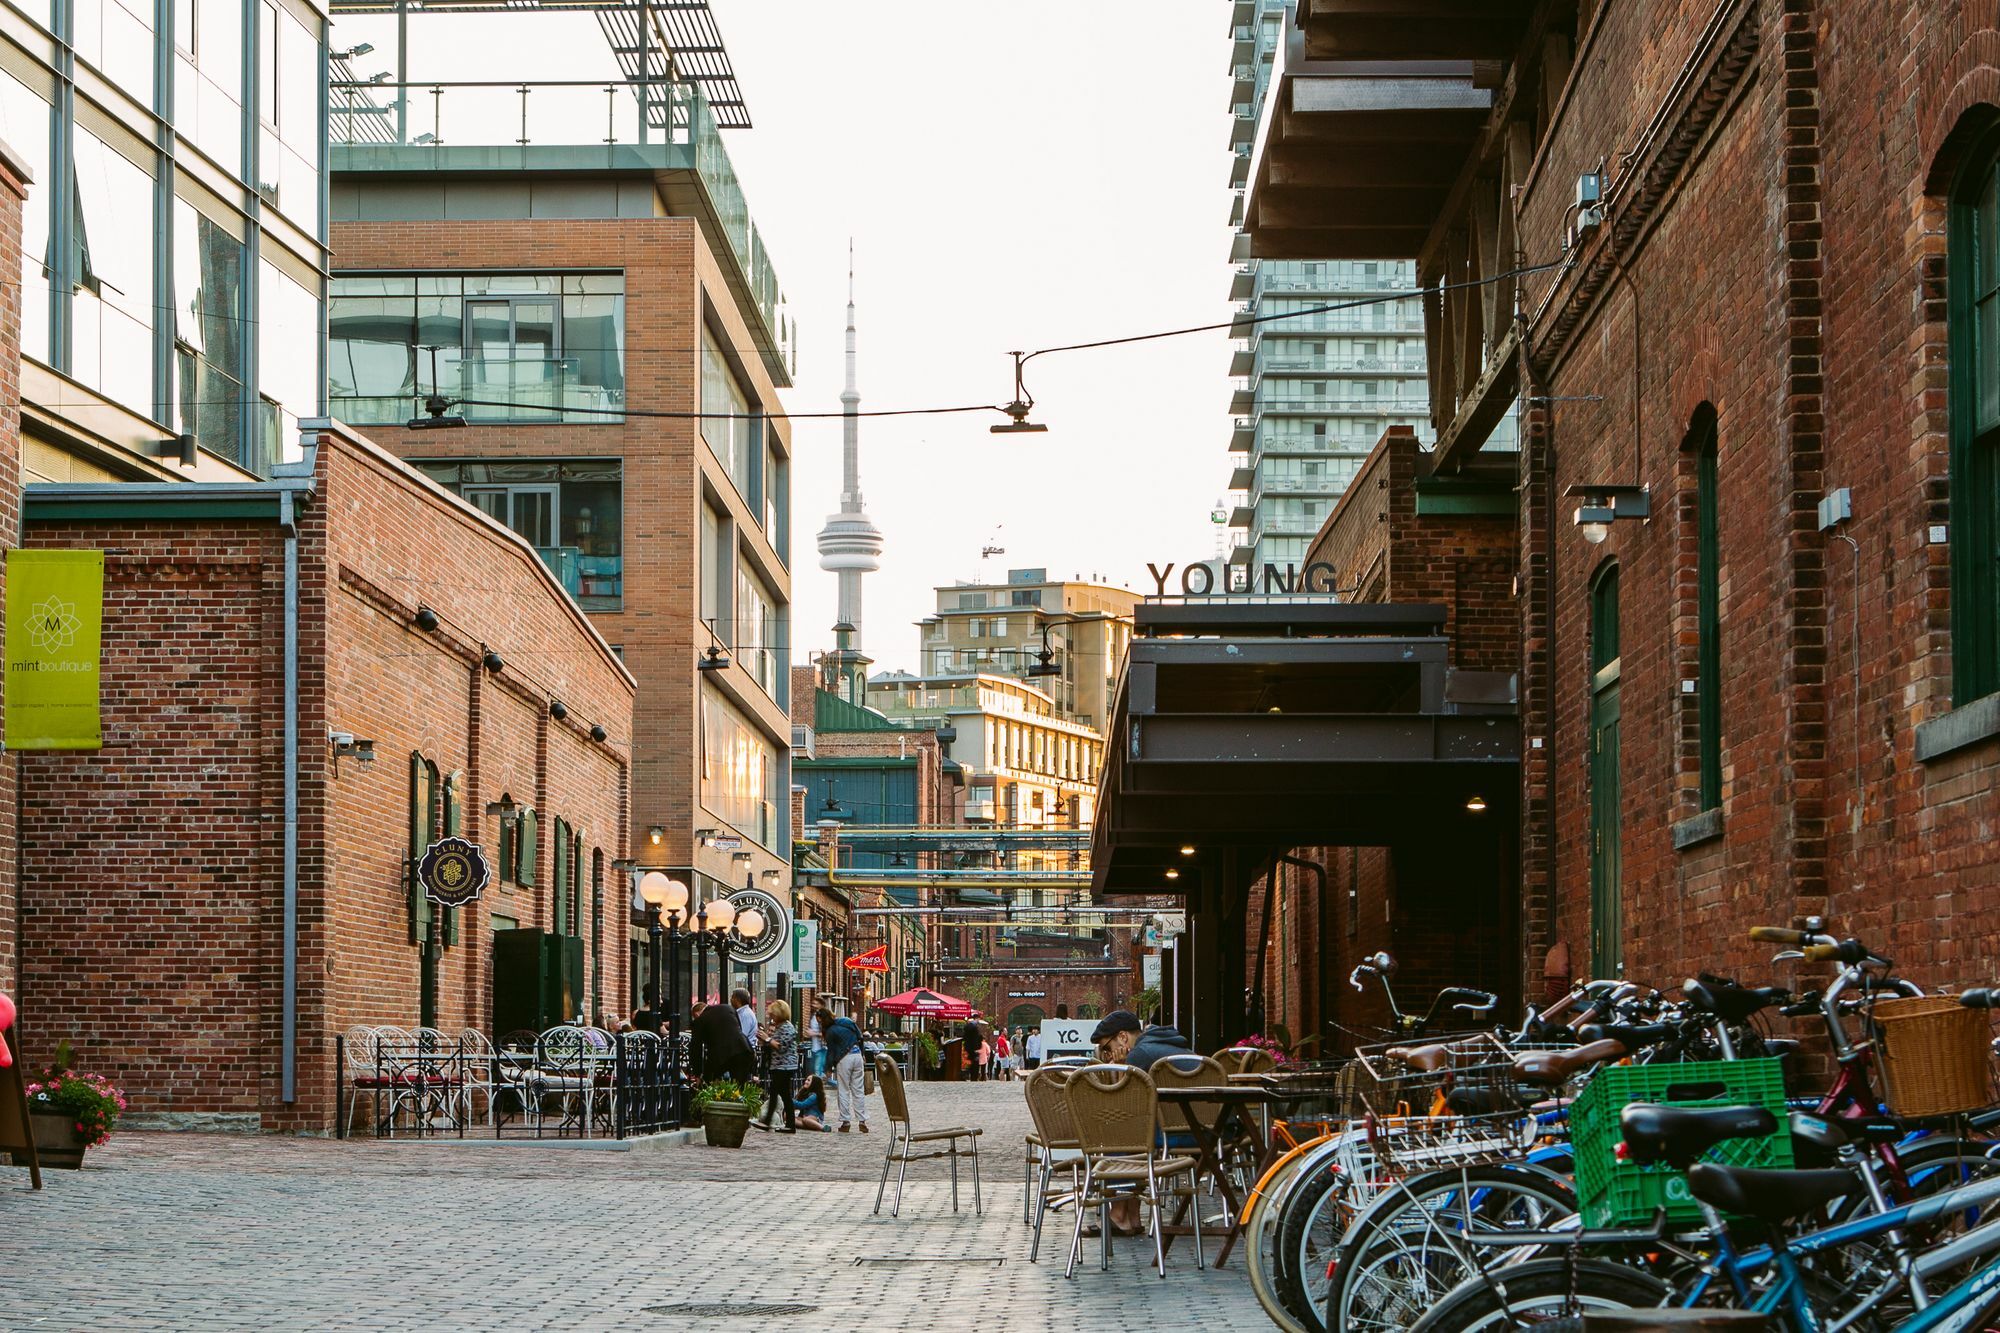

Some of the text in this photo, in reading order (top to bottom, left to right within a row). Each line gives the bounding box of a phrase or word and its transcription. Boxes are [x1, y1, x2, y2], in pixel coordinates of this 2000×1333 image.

[1146, 562, 1337, 594] YOUNG
[45, 617, 61, 631] M
[12, 659, 93, 673] mintboutique
[434, 844, 471, 856] CLUNY
[732, 897, 768, 909] CLUNY
[1057, 1029, 1082, 1044] Y.C.
